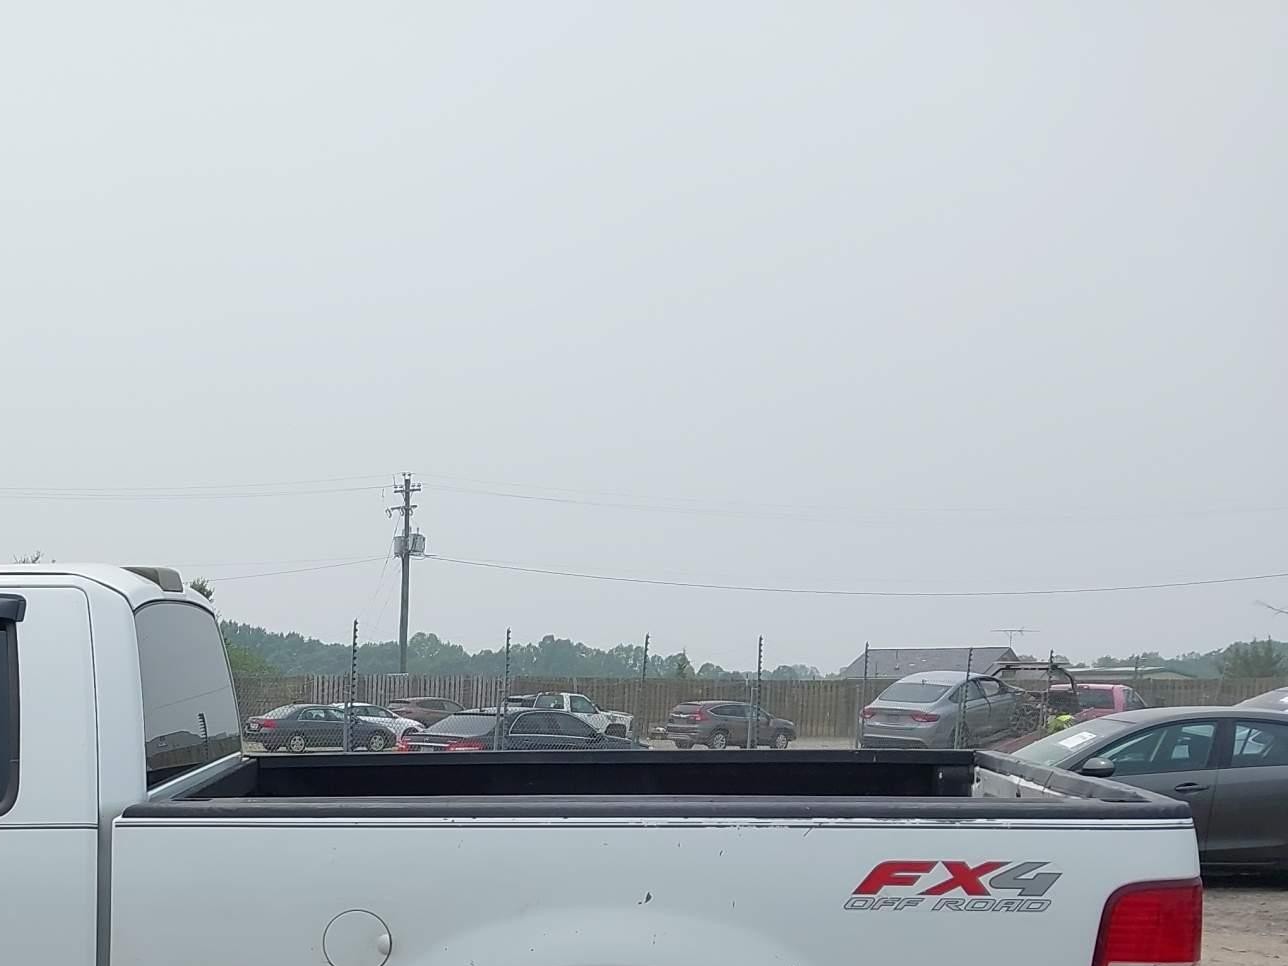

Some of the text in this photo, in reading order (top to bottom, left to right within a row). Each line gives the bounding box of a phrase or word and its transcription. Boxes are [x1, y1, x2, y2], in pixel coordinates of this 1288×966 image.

[852, 860, 1063, 897] FX4
[843, 896, 1052, 912] OFF ROAD
